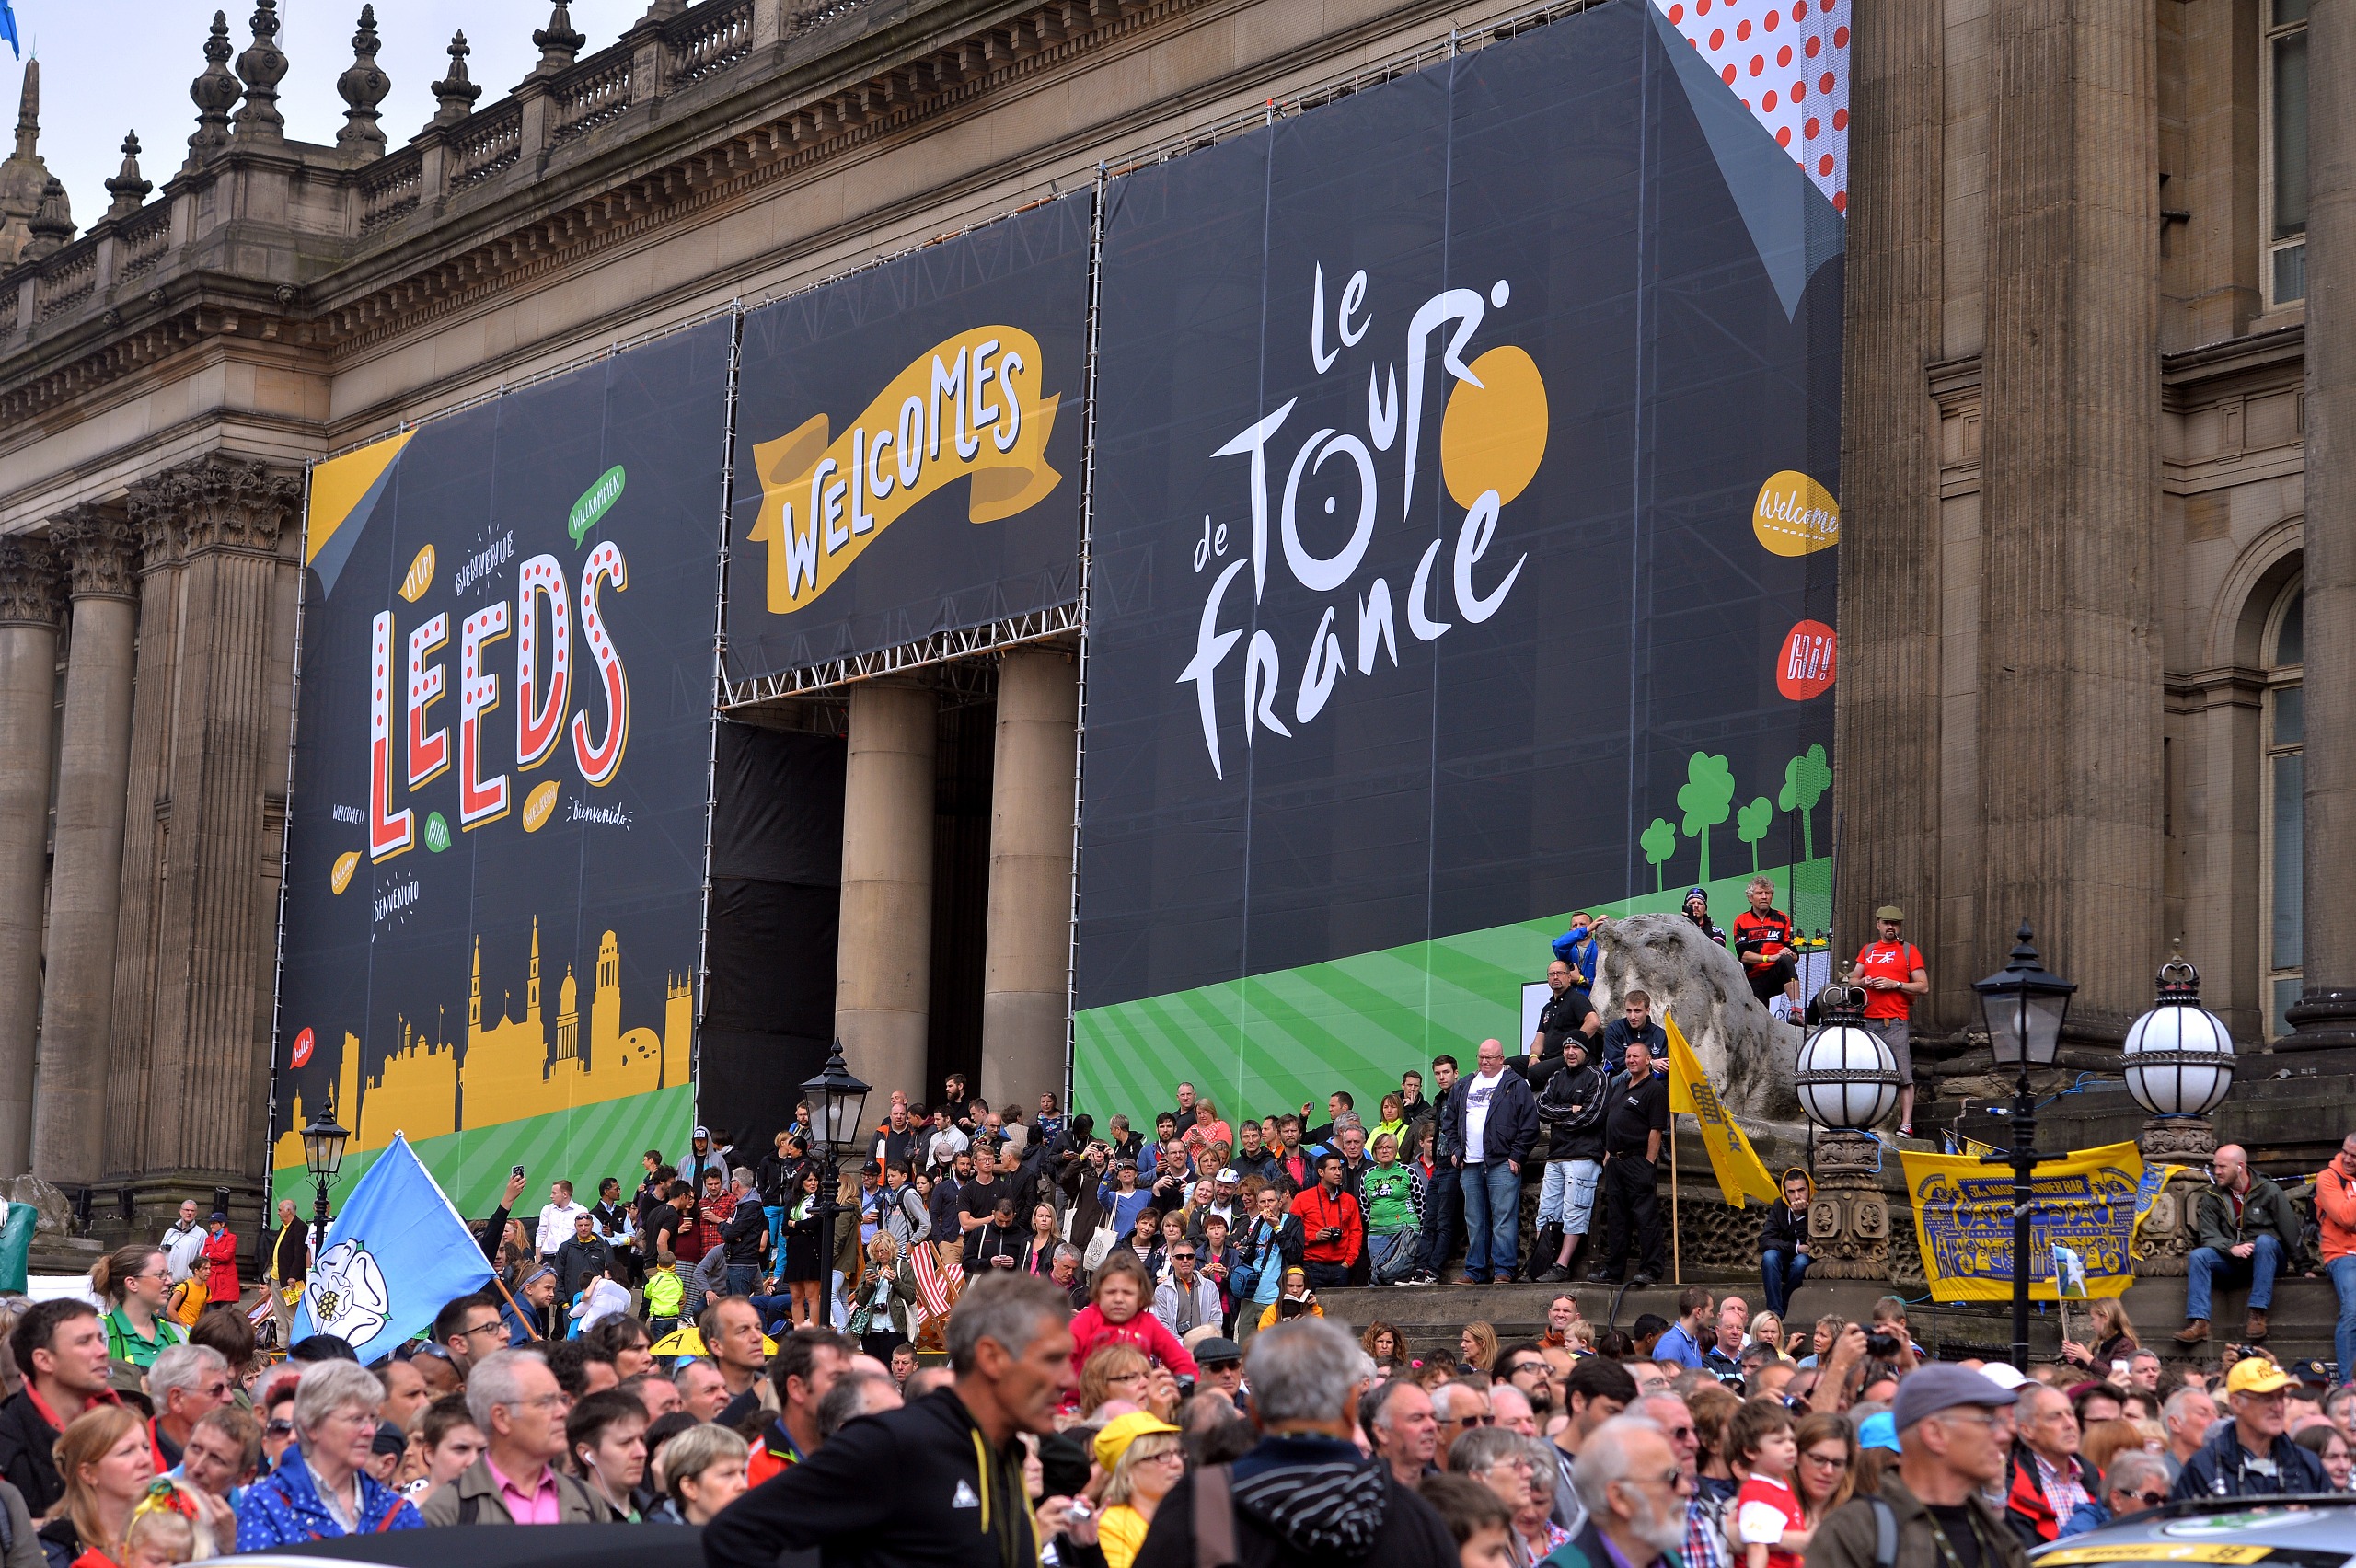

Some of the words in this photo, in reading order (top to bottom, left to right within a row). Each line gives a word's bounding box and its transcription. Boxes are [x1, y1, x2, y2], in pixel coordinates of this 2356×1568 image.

[782, 338, 1025, 602] WELCOMES
[572, 471, 620, 532] WILLKOMMEN
[1759, 488, 1839, 534] Welcome
[455, 529, 514, 597] BIENVENUE
[1194, 513, 1229, 573] de
[406, 568, 417, 599] EY
[416, 548, 433, 585] UP!
[1786, 633, 1832, 681] Hi!
[368, 540, 630, 864] LEEDS
[332, 803, 365, 825] WELCOME!!
[427, 817, 448, 848] HIYA!
[572, 799, 628, 826] Bienvenido
[332, 856, 356, 887] Welcome
[374, 880, 419, 923] BENVENUTO
[294, 1030, 313, 1063] hello!
[1968, 1184, 1991, 1198] The
[2062, 1179, 2086, 1193] BAR
